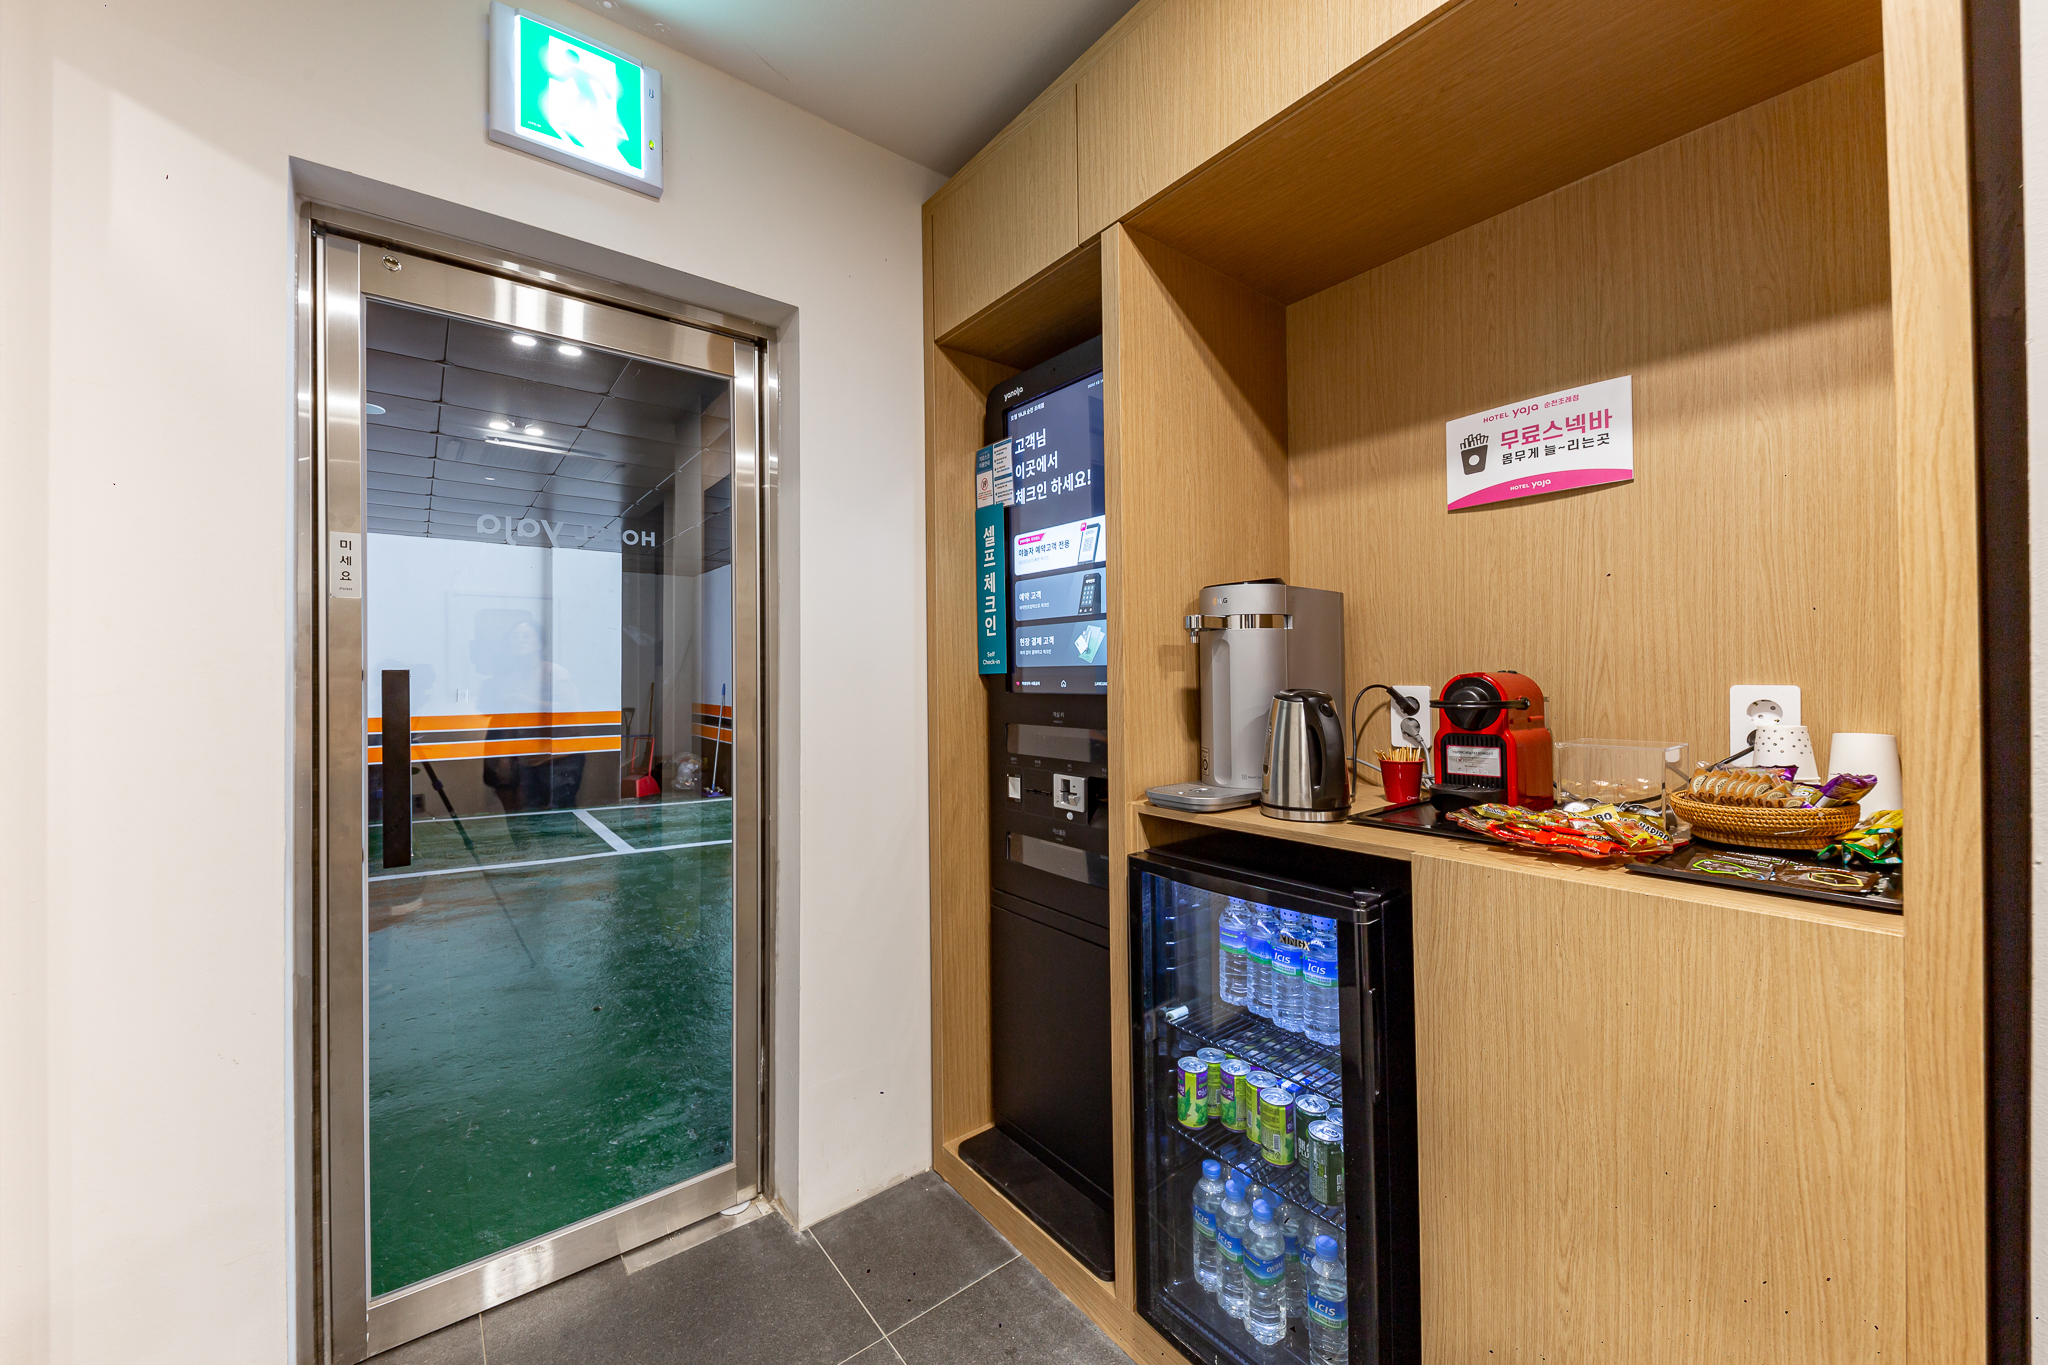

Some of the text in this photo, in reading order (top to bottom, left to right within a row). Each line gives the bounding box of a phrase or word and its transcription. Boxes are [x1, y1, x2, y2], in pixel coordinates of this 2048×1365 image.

[1483, 412, 1509, 424] HOTEL
[1543, 394, 1579, 409] 순천조례점
[1500, 408, 1613, 450] 무료스넥바
[1014, 428, 1047, 455] 고객님
[1015, 450, 1059, 480] 이곳에서
[1502, 446, 1540, 466] 몸무게
[1015, 481, 1048, 505] 체크인
[1051, 469, 1092, 495] 하세요!
[1510, 483, 1530, 491] HOTEL
[339, 540, 352, 582] 미세요
[1274, 952, 1291, 964] ICIS
[1307, 963, 1326, 975] ICIS
[1195, 1210, 1209, 1225] ICIS
[1217, 1232, 1232, 1249] ICIS
[1314, 1300, 1336, 1317] ICIS
